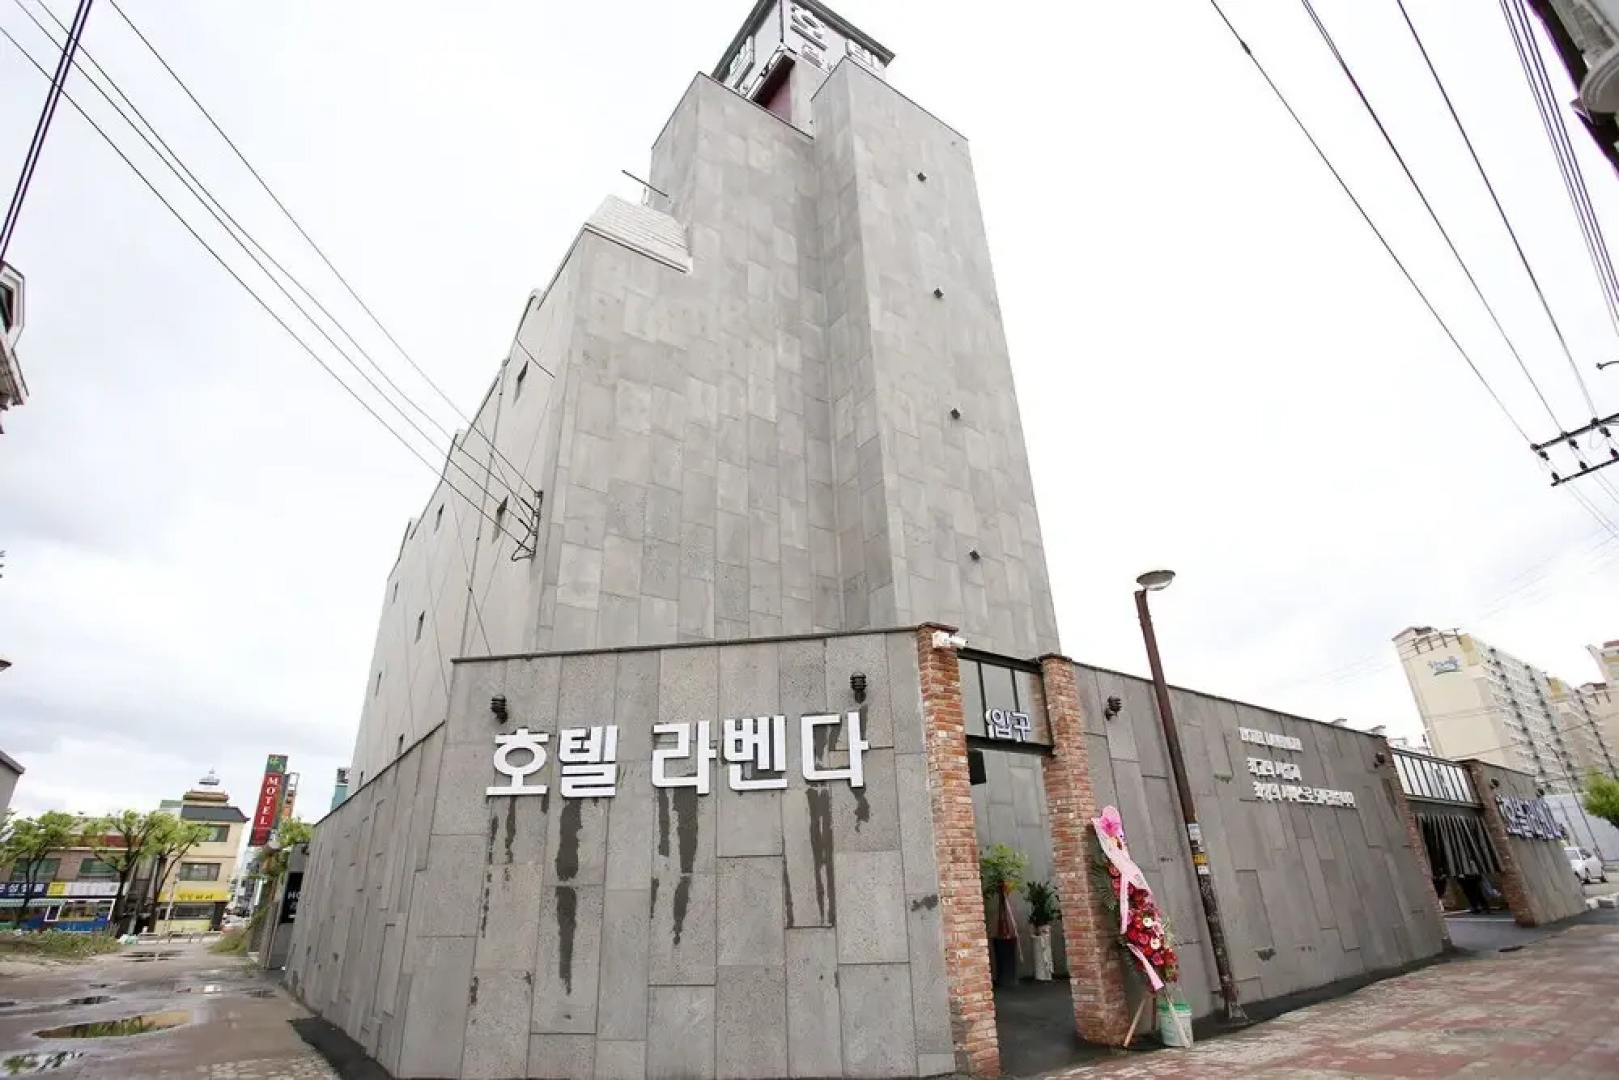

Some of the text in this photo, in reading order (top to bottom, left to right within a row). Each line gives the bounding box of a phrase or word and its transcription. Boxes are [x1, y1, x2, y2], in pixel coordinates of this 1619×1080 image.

[986, 708, 1031, 742] 입구
[485, 712, 869, 798] 호텔 라벤다
[260, 776, 279, 825] MOTEL
